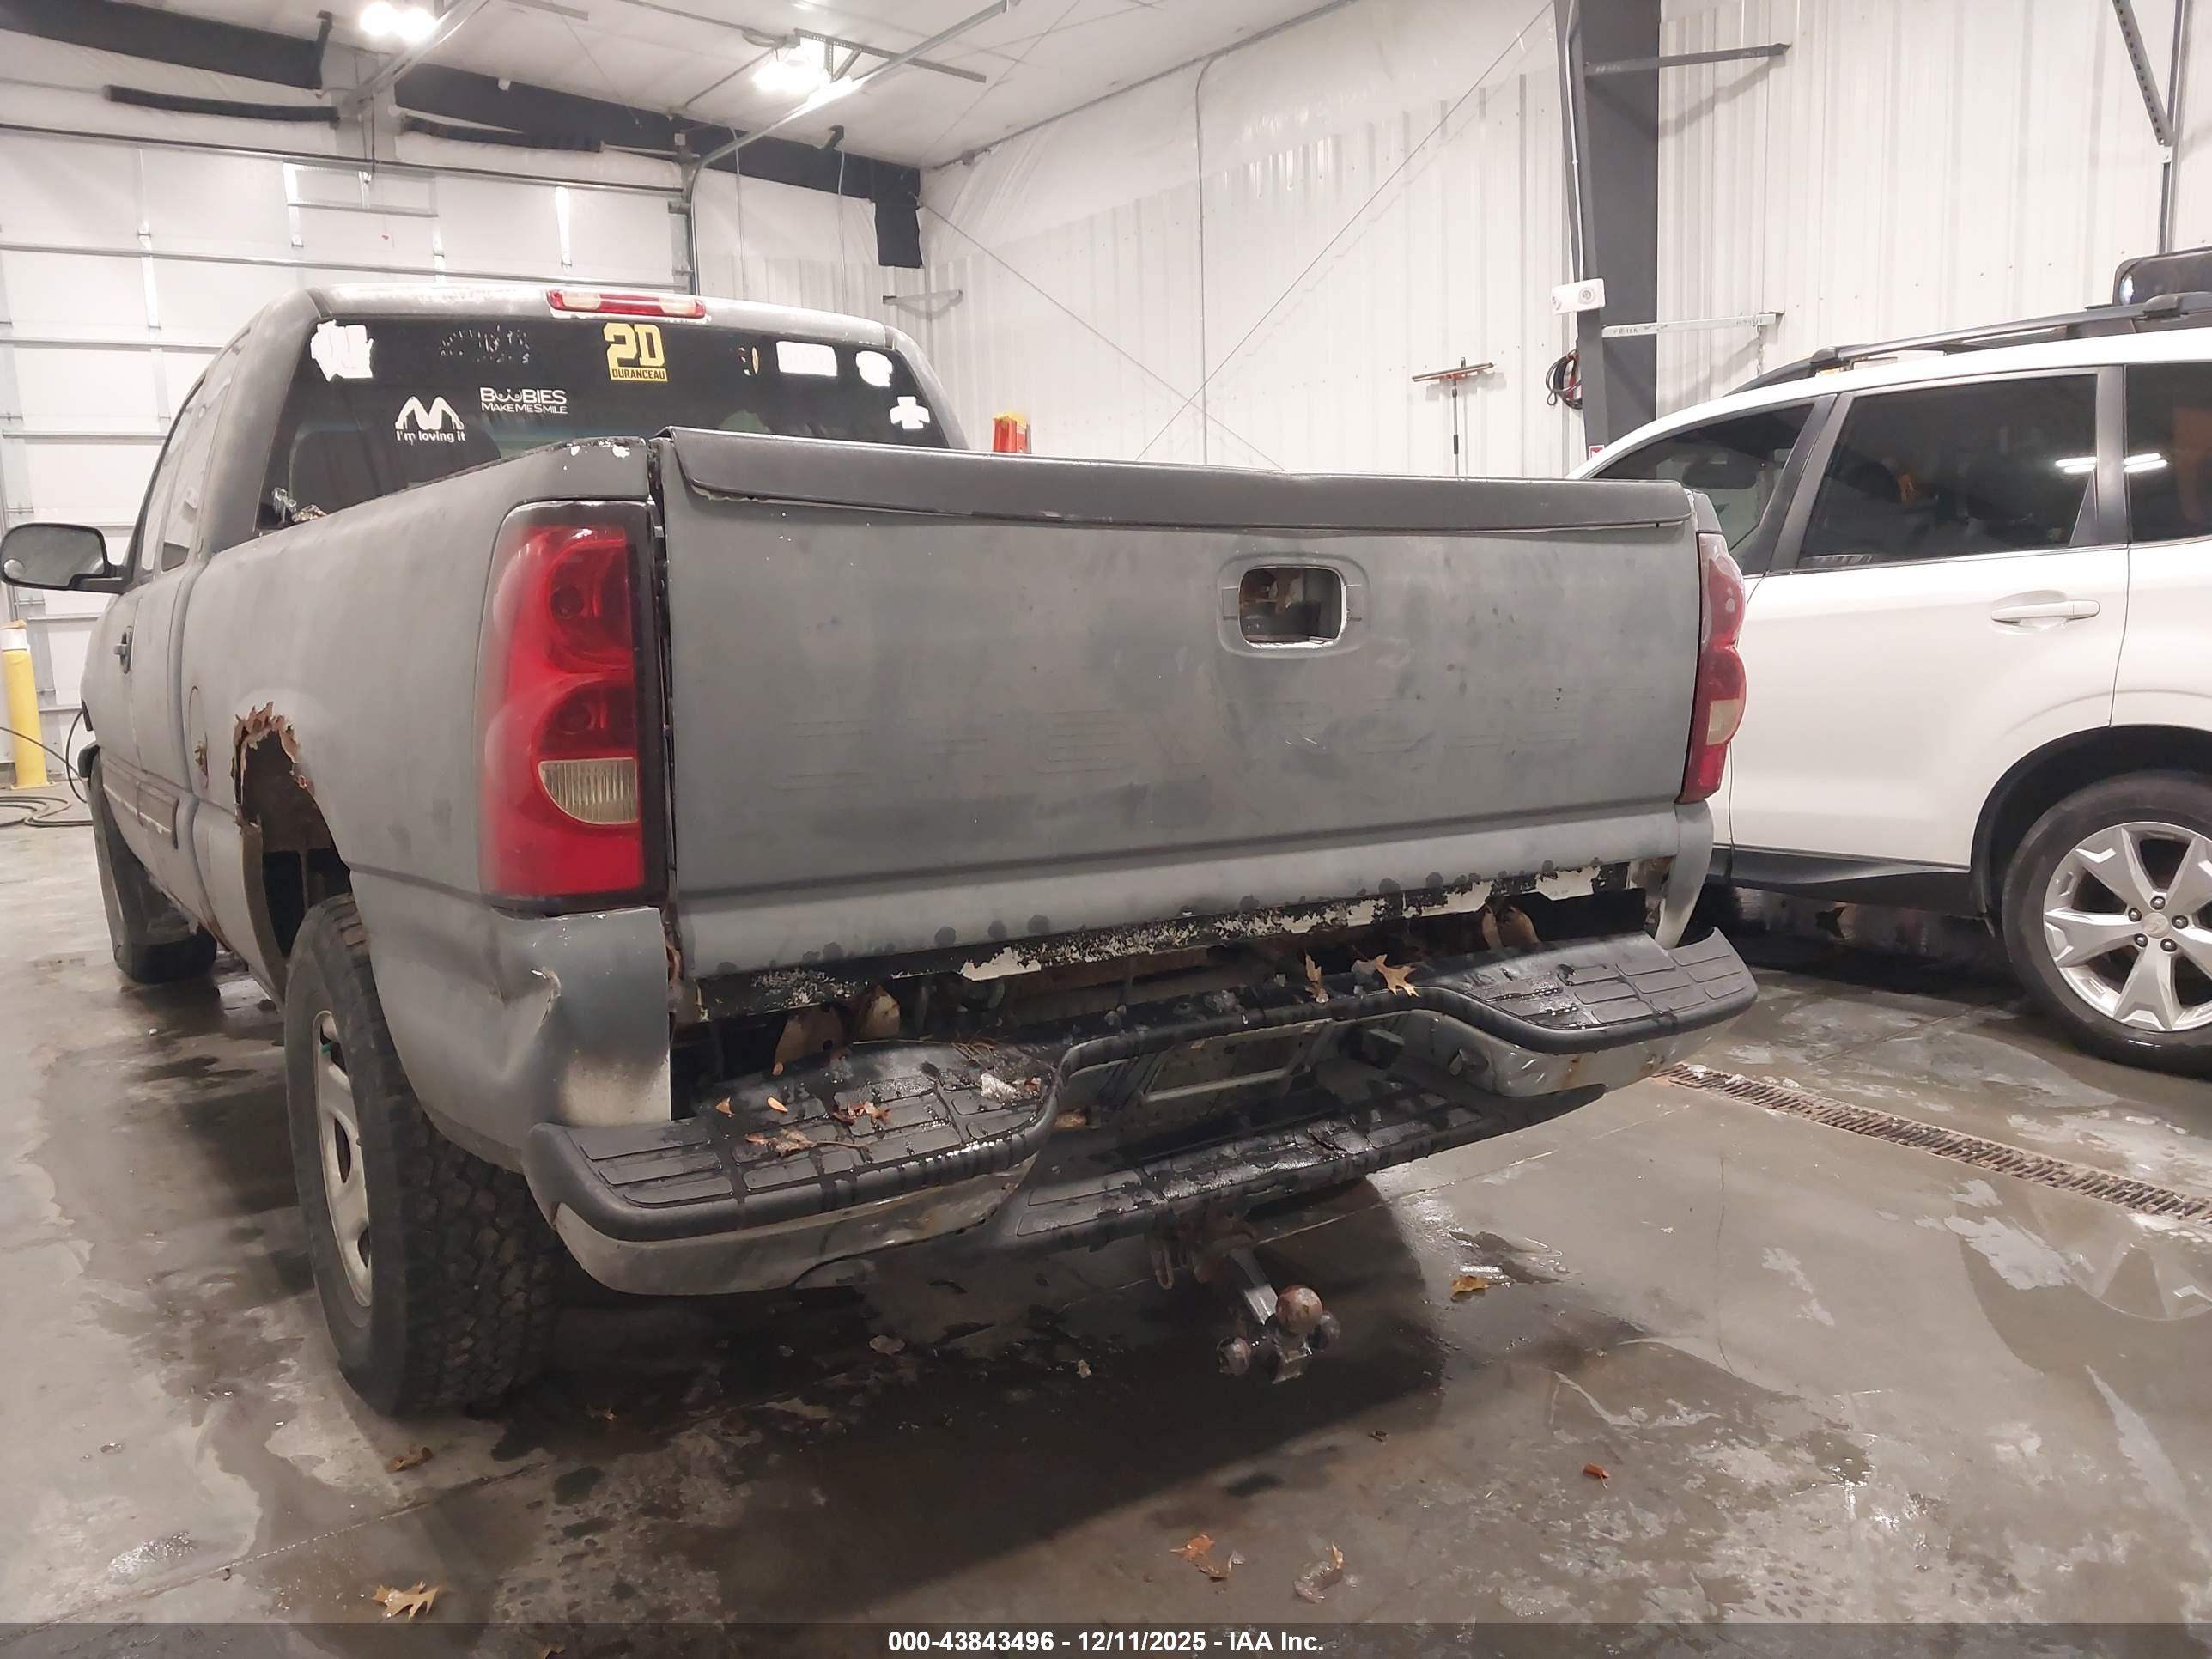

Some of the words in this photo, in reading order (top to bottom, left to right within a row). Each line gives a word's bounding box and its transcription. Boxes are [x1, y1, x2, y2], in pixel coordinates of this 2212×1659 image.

[611, 368, 665, 380] DURANCEAU
[396, 430, 416, 441] I'm
[418, 430, 455, 443] loving
[457, 431, 466, 441] it
